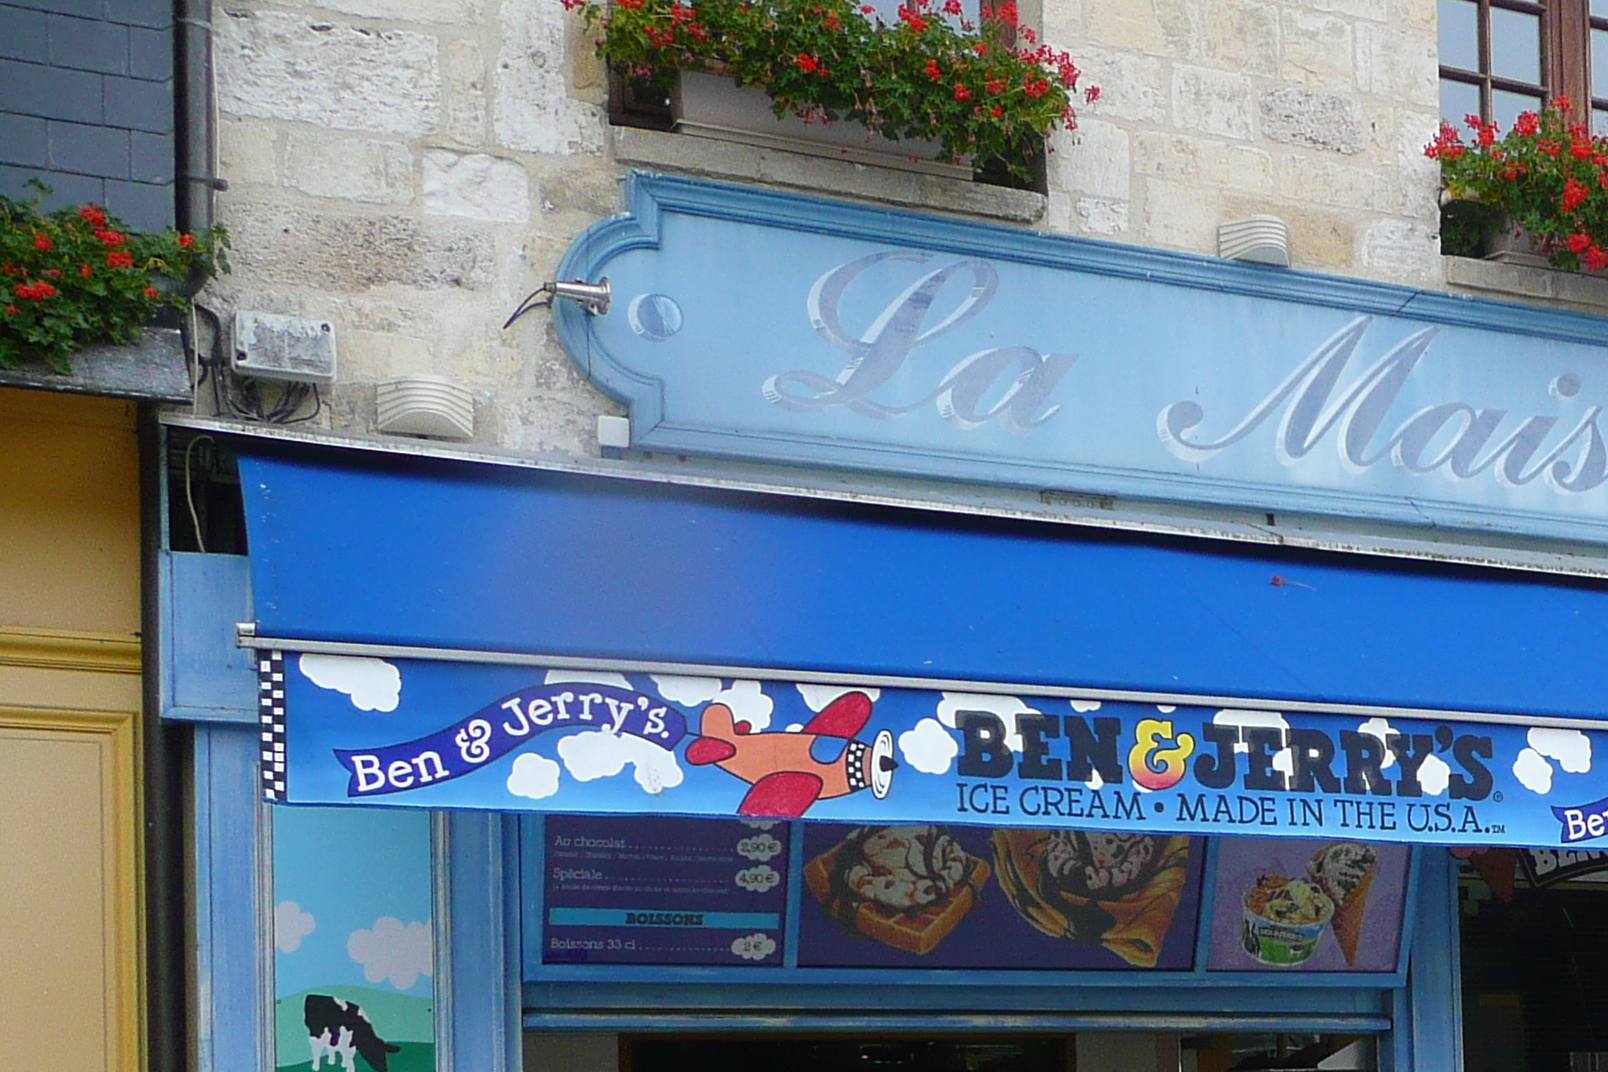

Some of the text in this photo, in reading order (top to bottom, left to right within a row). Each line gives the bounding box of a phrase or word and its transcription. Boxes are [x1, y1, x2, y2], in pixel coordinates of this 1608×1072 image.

[762, 249, 1077, 434] La
[350, 746, 450, 793] Ben
[455, 719, 492, 764] &
[955, 710, 1494, 801] BEN & JERRY'S
[956, 783, 1010, 815] ICE
[1018, 786, 1144, 821] CREAM
[1176, 793, 1279, 827] MADE
[1287, 797, 1325, 829] IN
[1333, 800, 1398, 832] THE
[554, 835, 571, 847] Au
[574, 835, 627, 849] chocolat
[552, 867, 603, 880] Spéciale
[625, 912, 704, 926] BOISSONS
[551, 938, 604, 950] Boissons
[606, 939, 622, 950] 33
